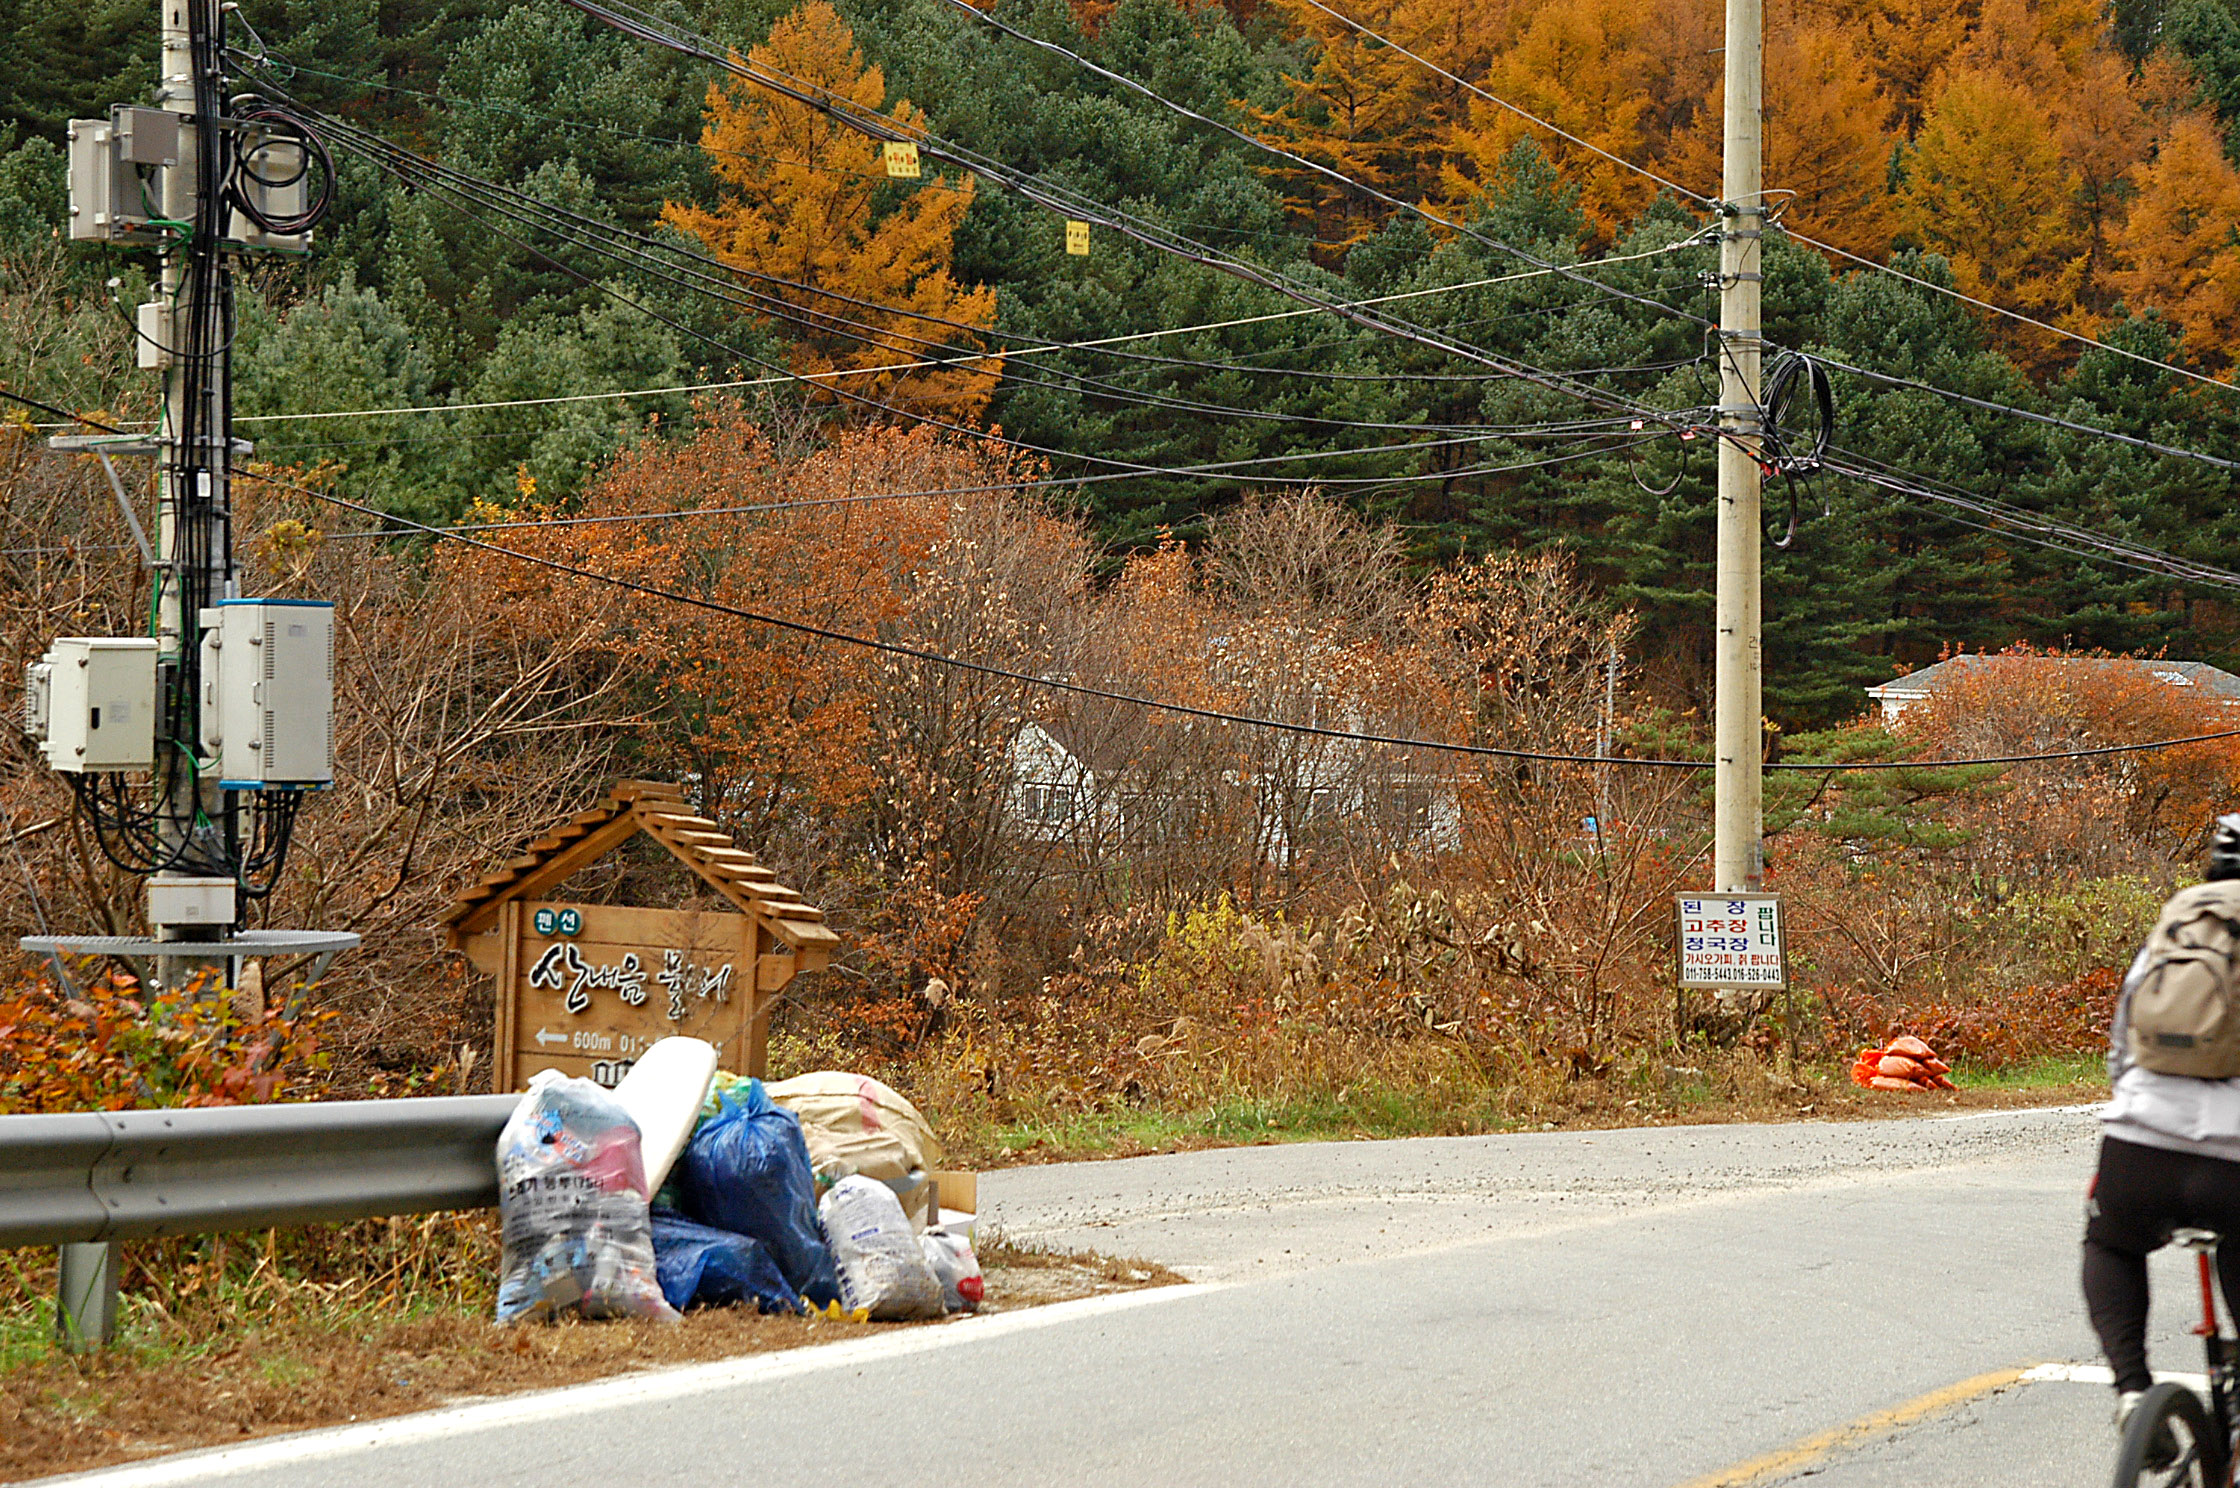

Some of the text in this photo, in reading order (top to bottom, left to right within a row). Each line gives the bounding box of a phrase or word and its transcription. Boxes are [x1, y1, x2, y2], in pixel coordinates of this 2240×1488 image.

[537, 911, 577, 932] 펜션
[1685, 919, 1748, 933] 고추장
[1757, 907, 1775, 946] 팝니다
[573, 1031, 612, 1051] 600m
